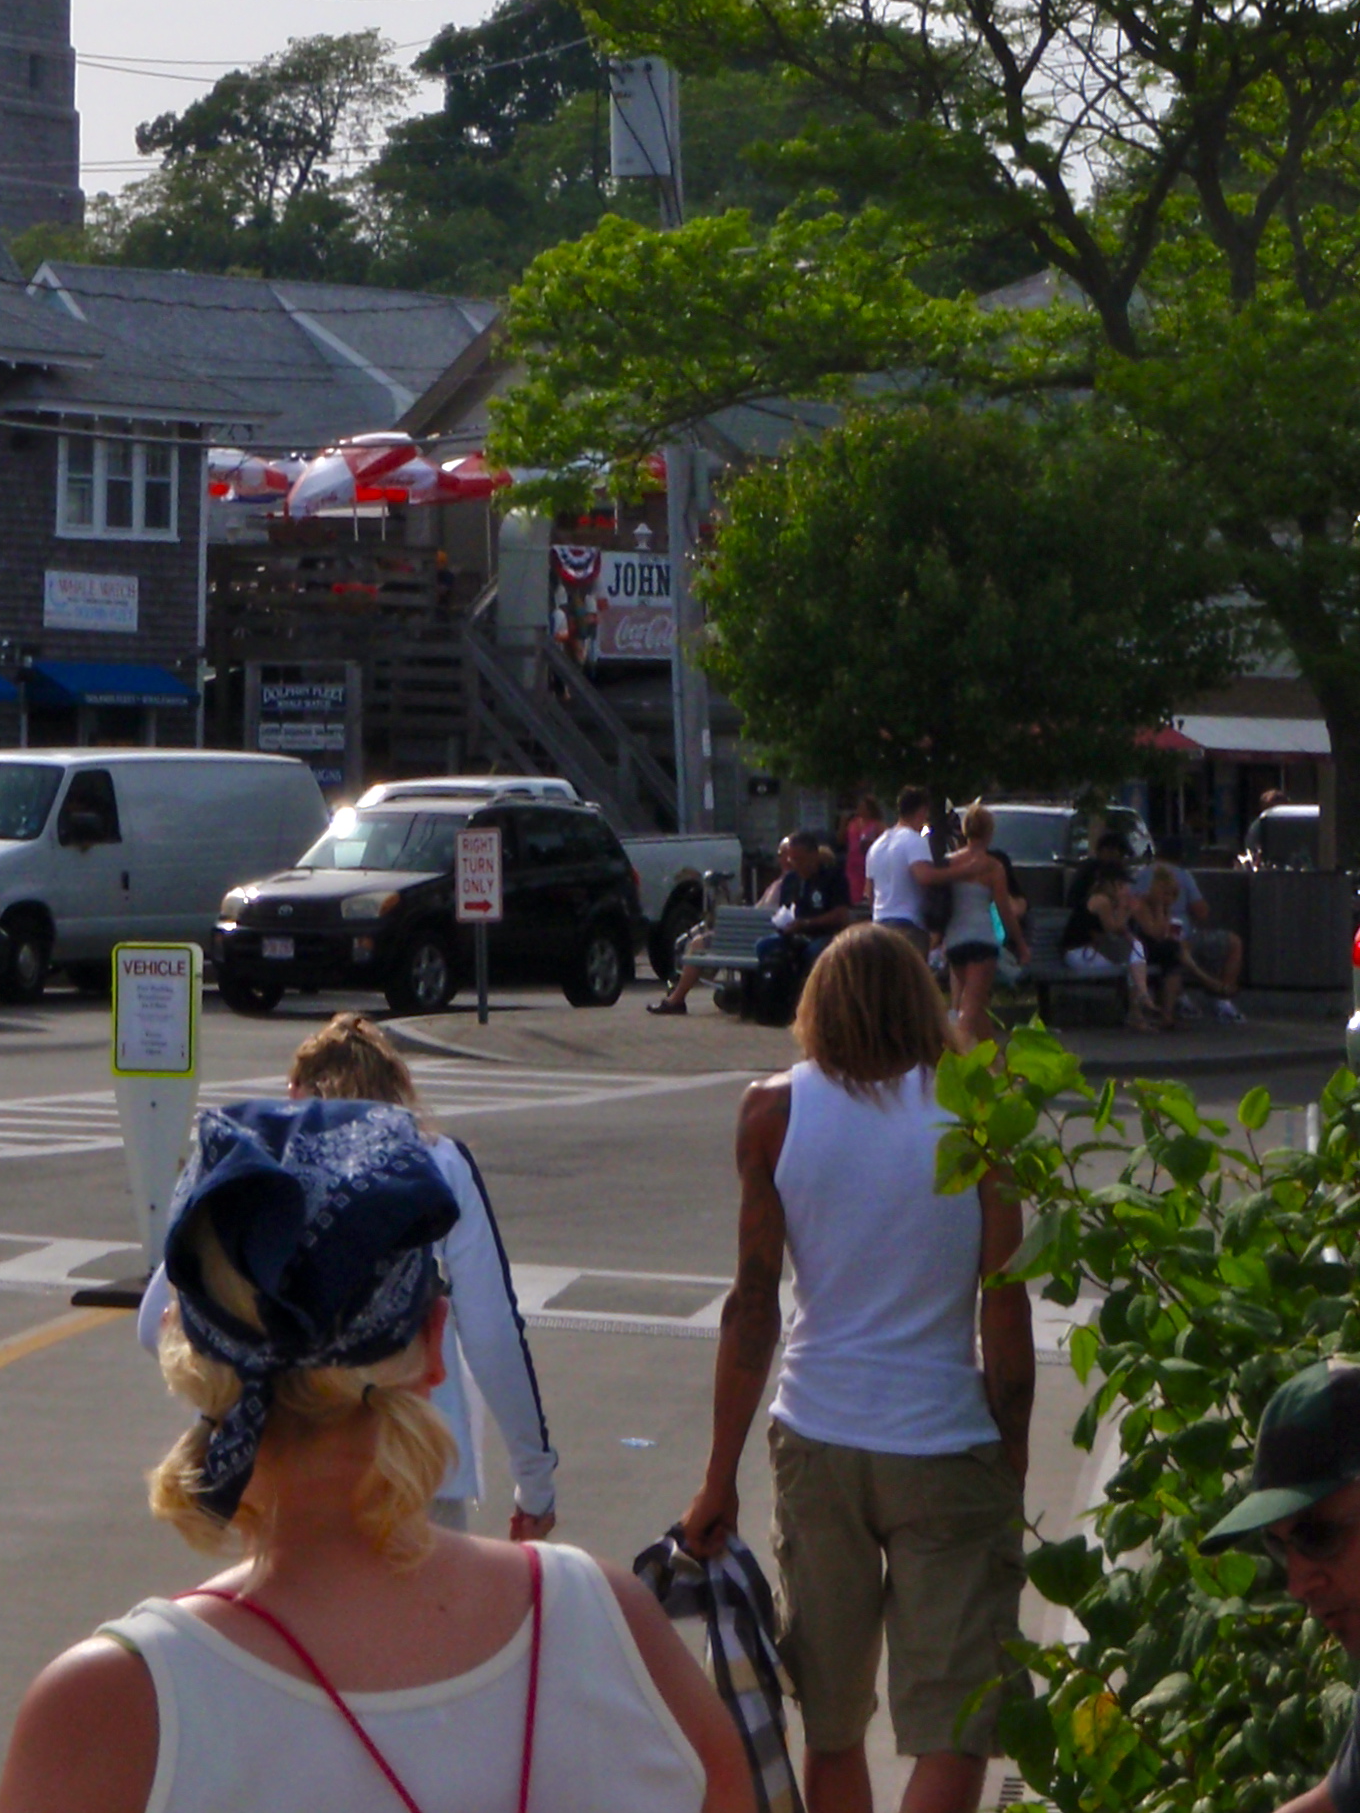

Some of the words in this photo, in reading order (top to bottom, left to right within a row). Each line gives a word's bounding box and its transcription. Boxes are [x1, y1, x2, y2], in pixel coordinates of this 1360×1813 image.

[263, 686, 310, 704] DOLPHIN
[312, 686, 344, 703] FLEET
[462, 837, 494, 853] RIGHT
[463, 857, 494, 874] TURN
[463, 878, 494, 894] ONLY
[123, 960, 186, 976] VEHICLE
